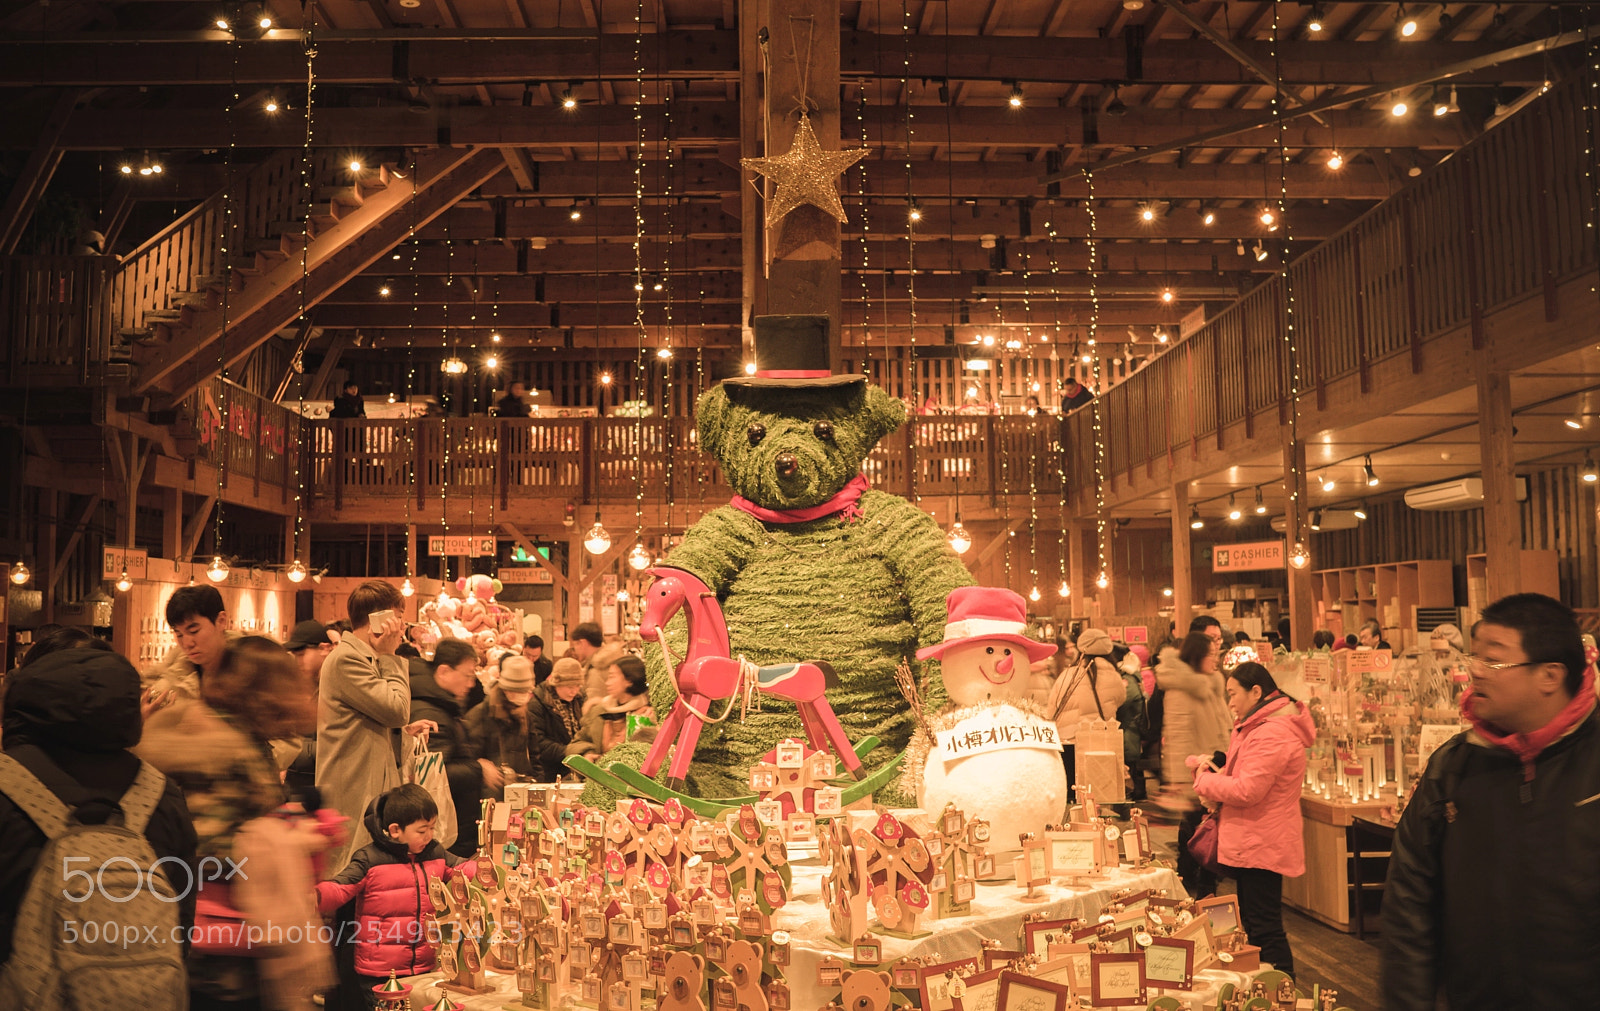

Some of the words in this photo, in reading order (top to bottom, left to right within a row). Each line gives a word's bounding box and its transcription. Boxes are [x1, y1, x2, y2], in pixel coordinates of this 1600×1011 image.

[446, 540, 479, 548] TOILET
[1233, 547, 1280, 560] CASHIER
[116, 555, 144, 568] CASHIER
[947, 725, 1057, 753] 小樽オルゴール堂
